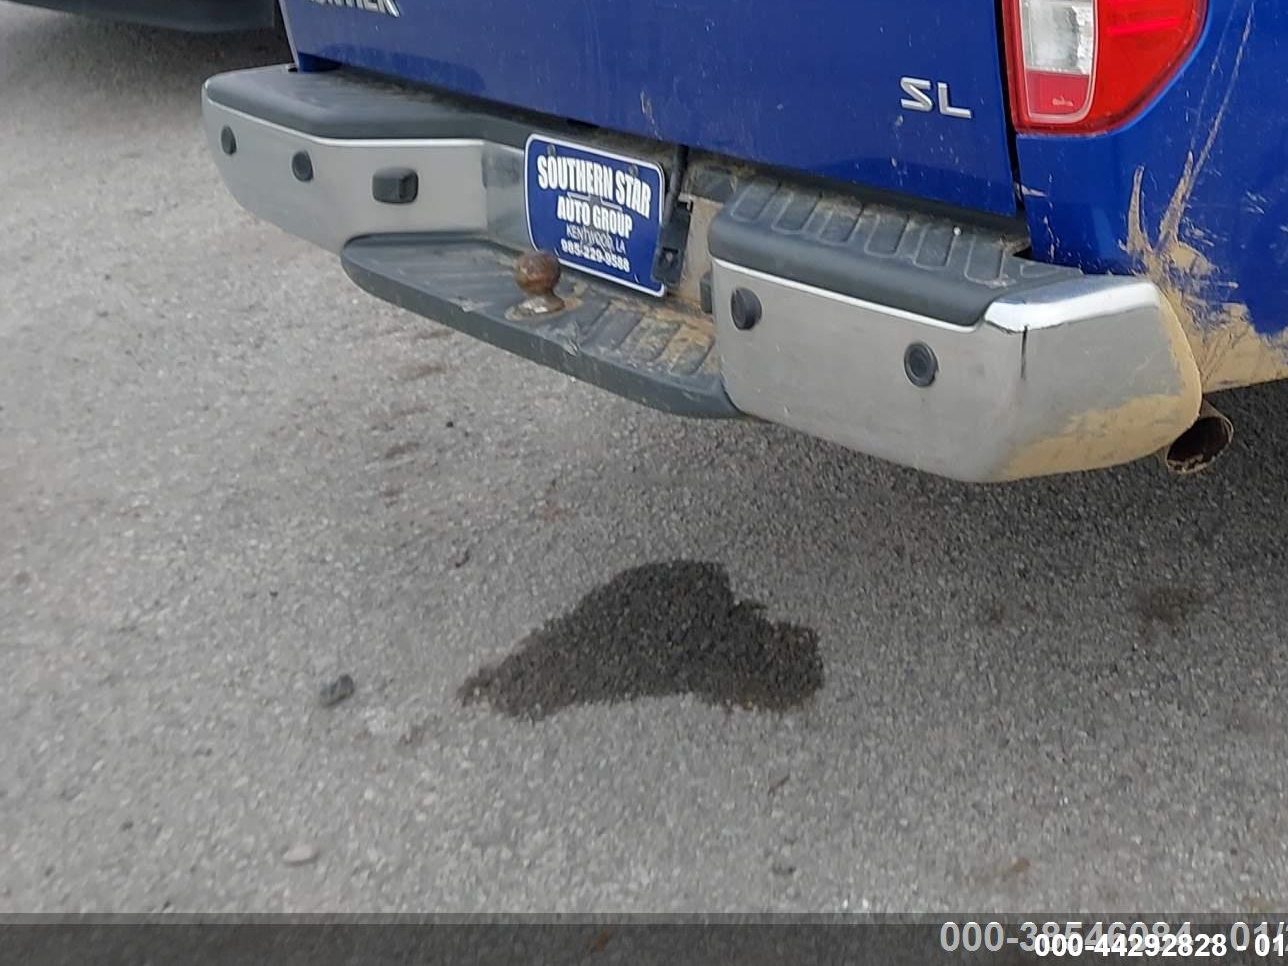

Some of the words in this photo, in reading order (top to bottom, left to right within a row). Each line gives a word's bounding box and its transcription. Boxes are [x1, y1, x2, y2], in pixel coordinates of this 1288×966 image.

[900, 76, 972, 119] SL
[537, 155, 613, 202] SOUTHERN
[615, 169, 651, 219] STAR
[557, 195, 591, 226] AUTO
[592, 205, 633, 239] GROUP
[615, 237, 626, 255] LA
